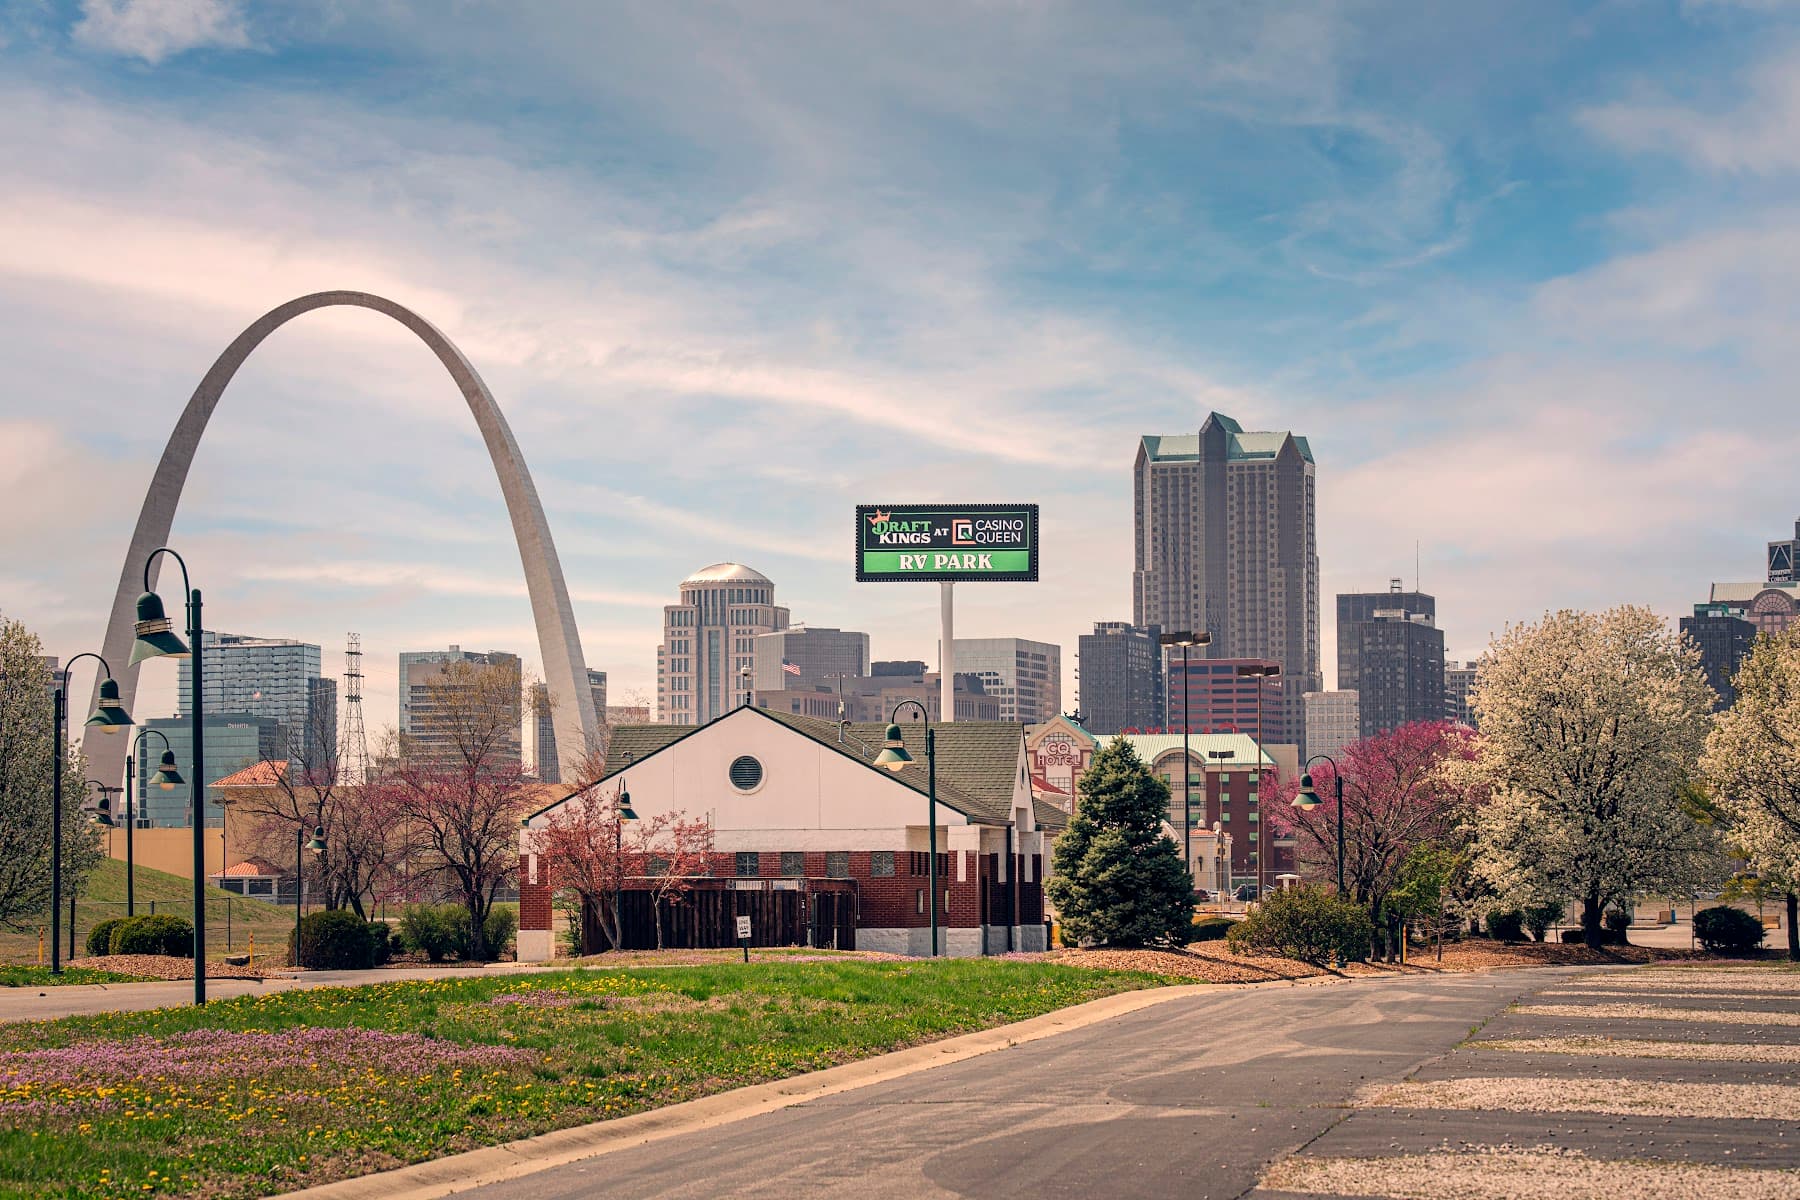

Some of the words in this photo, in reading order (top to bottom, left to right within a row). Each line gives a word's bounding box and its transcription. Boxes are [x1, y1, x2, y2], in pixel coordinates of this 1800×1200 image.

[871, 520, 932, 535] DRAFT
[975, 519, 1024, 531] CASINO
[879, 532, 932, 544] KINGS
[933, 528, 949, 537] AT
[975, 531, 1021, 544] QUEEN
[898, 554, 928, 570] RV
[934, 553, 993, 569] PARK
[1046, 742, 1071, 755] CQ
[1037, 755, 1081, 766] HOTEL
